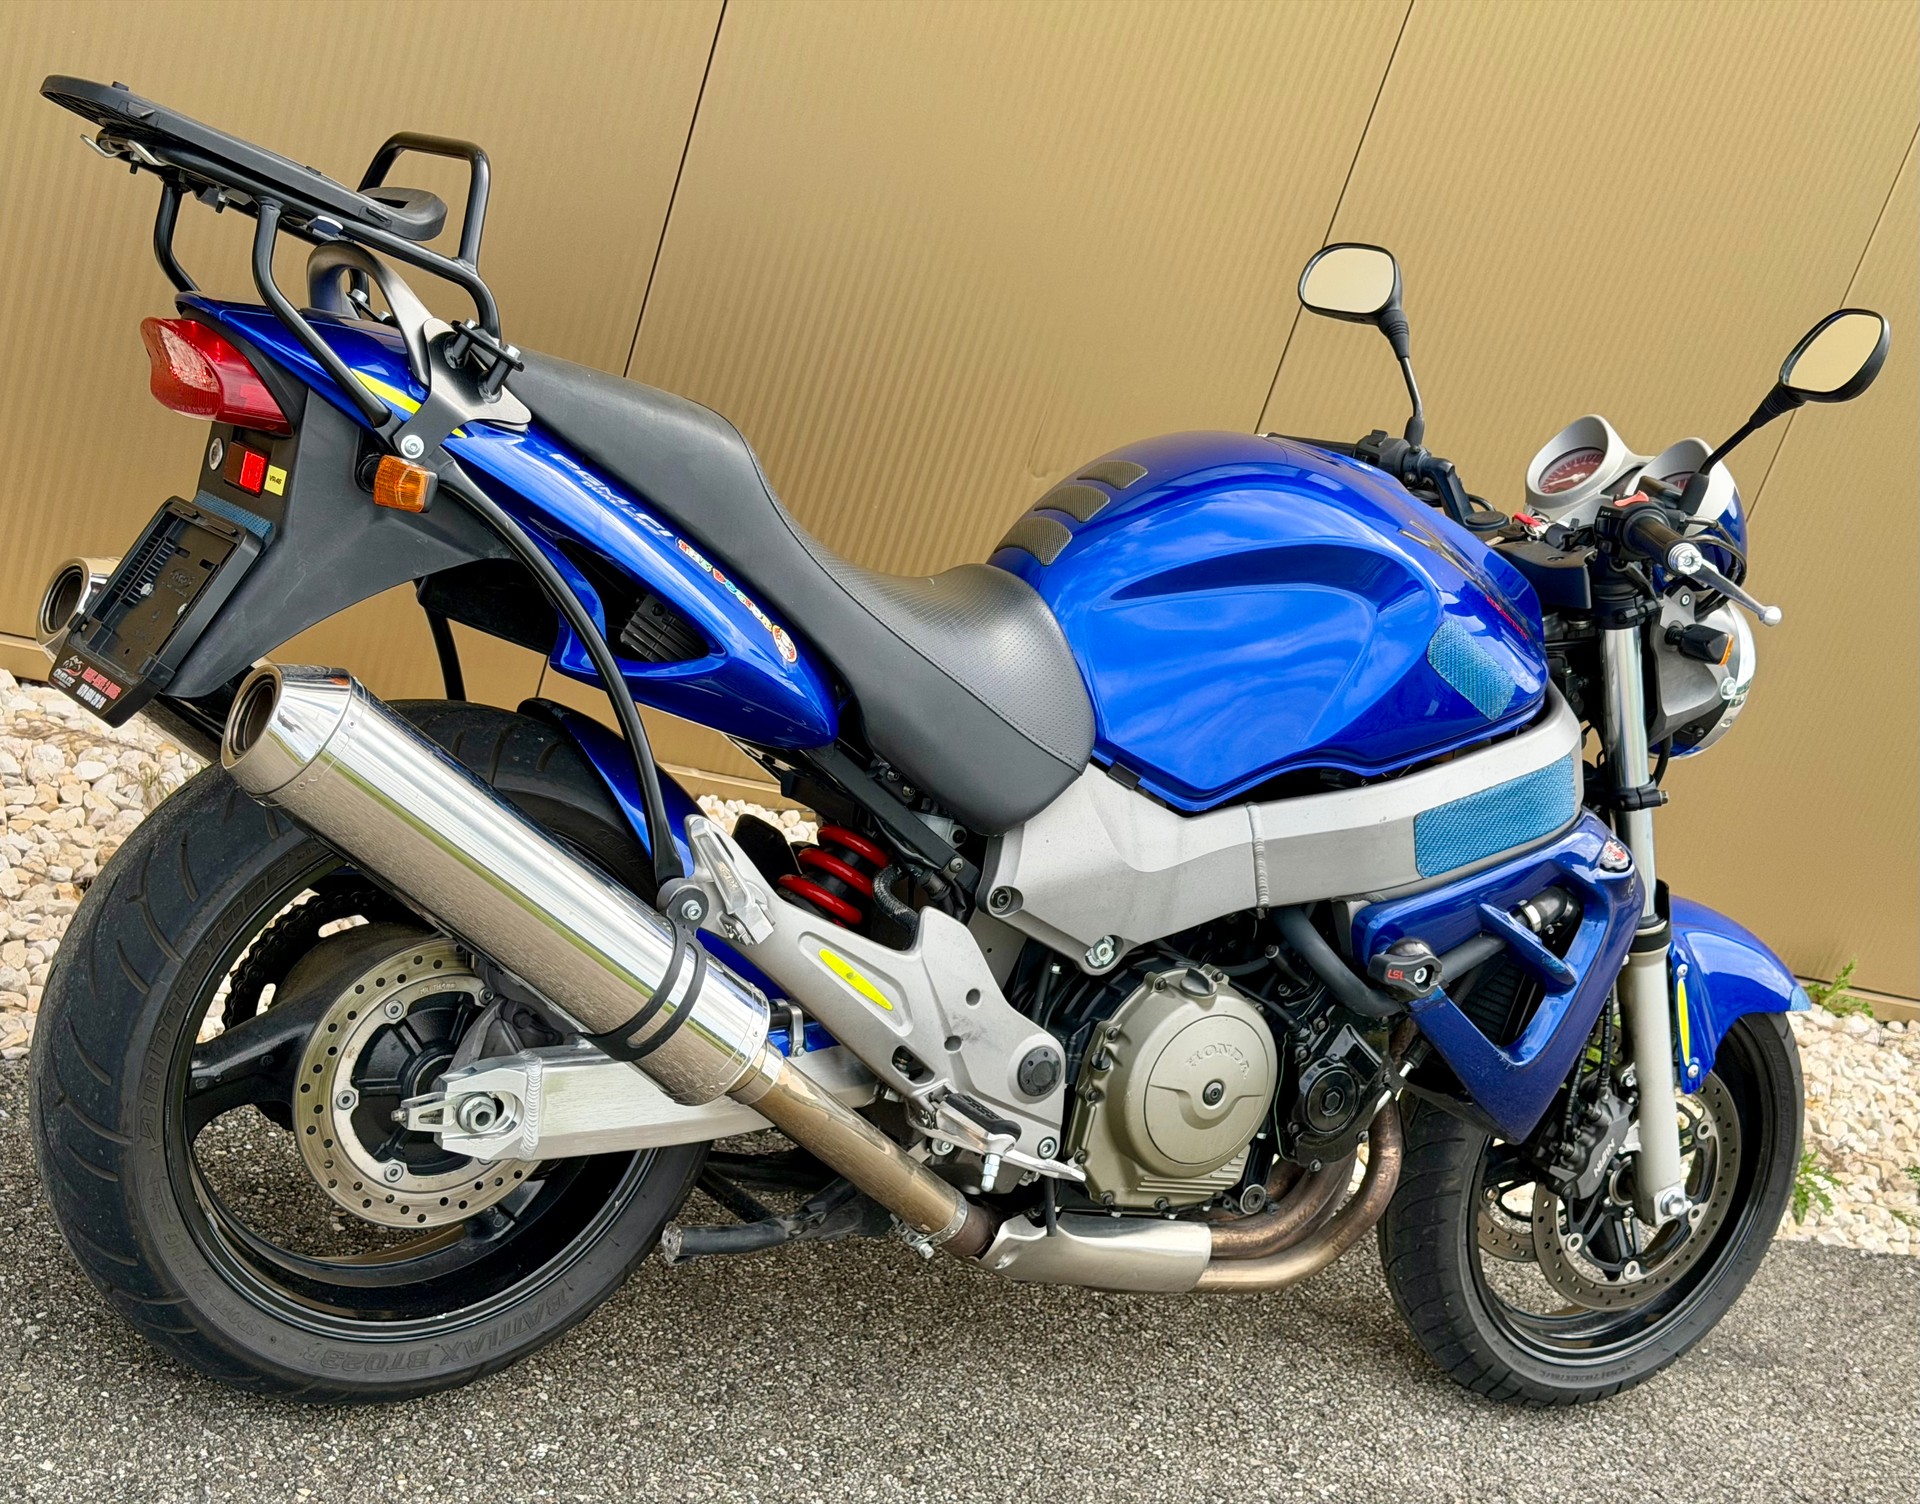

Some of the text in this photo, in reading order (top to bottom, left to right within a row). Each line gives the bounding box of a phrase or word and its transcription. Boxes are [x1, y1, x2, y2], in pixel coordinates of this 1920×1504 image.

[549, 453, 674, 537] PGM-FI
[1387, 969, 1404, 980] LSL
[1185, 1042, 1250, 1080] HONDA
